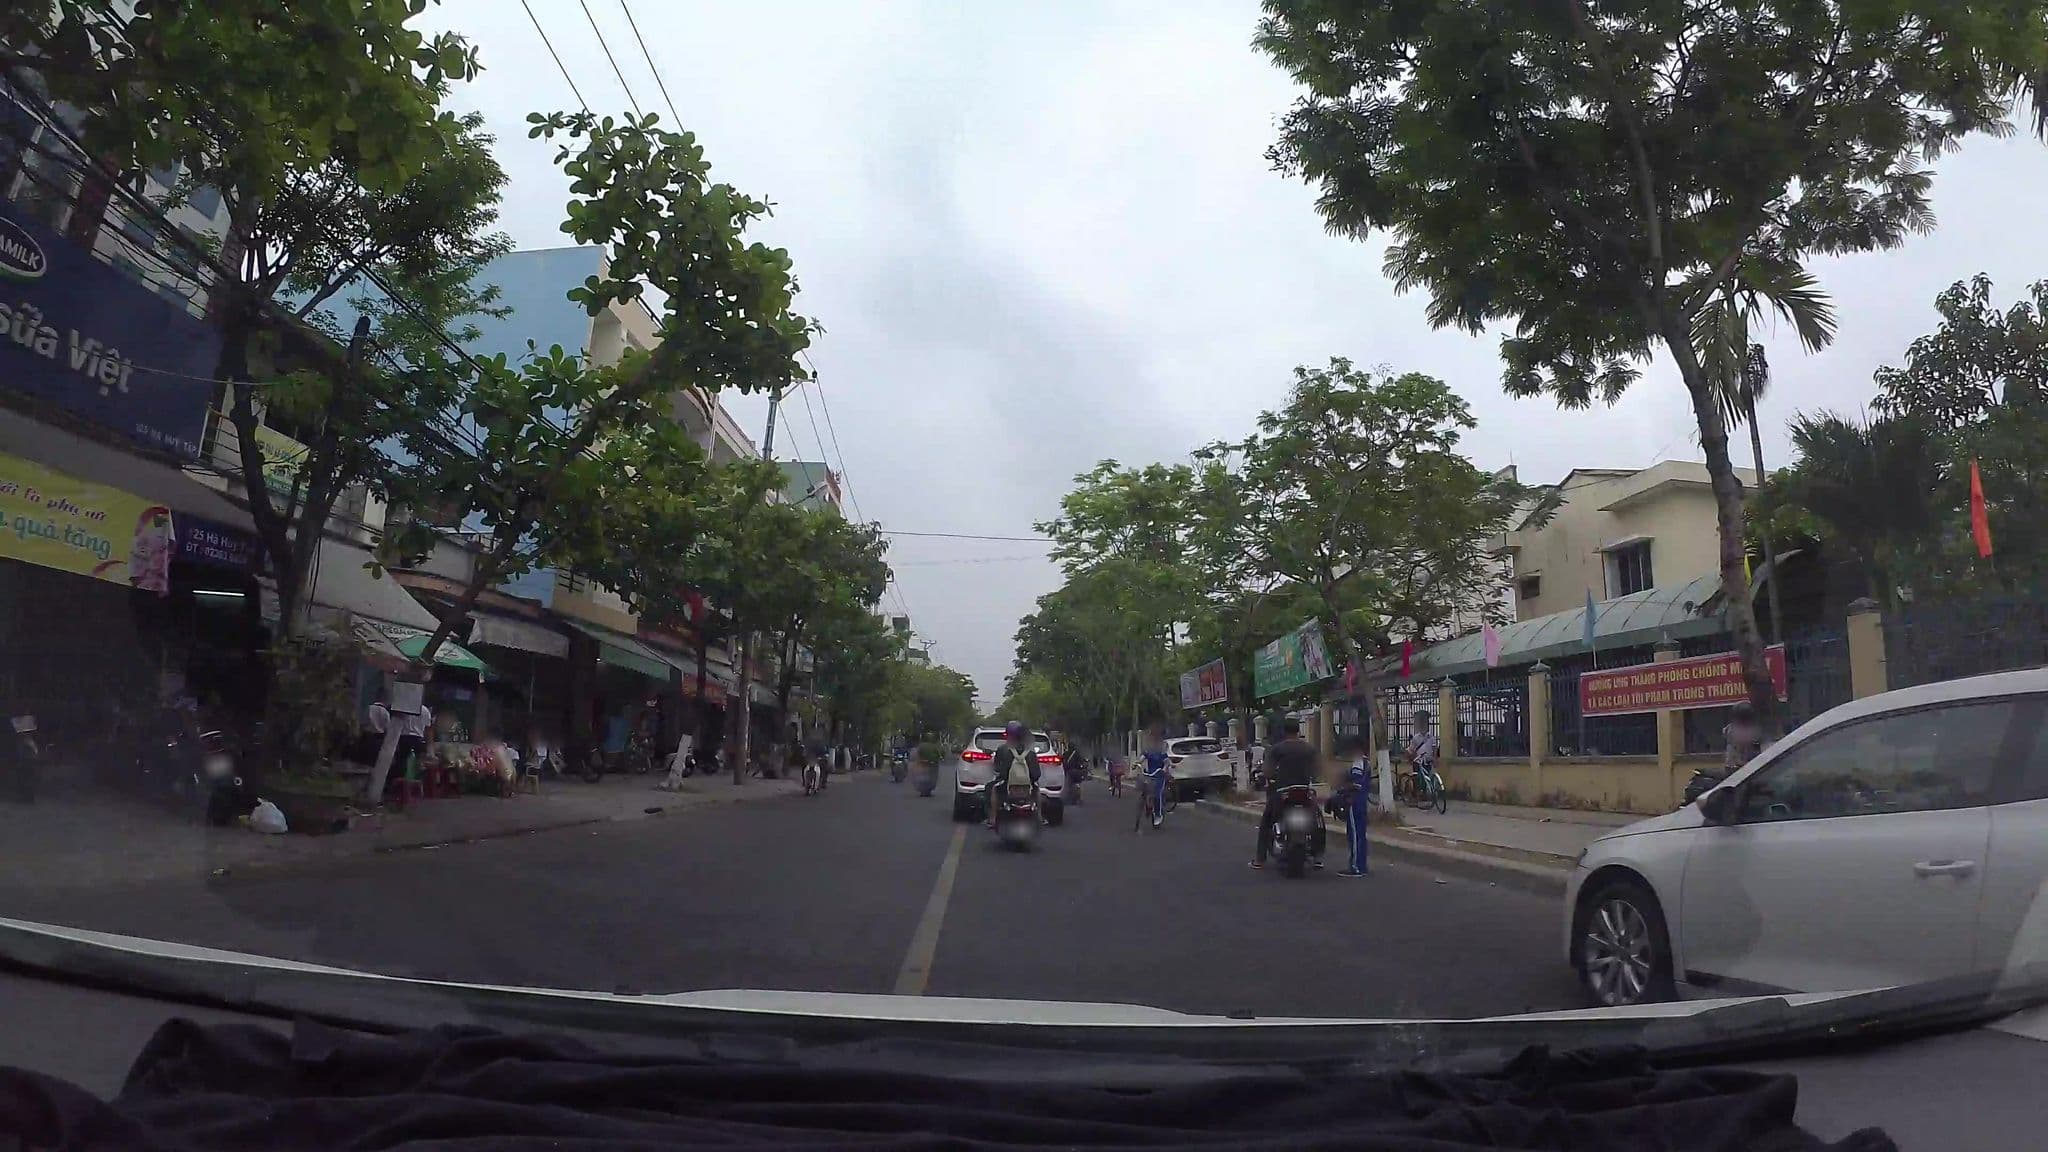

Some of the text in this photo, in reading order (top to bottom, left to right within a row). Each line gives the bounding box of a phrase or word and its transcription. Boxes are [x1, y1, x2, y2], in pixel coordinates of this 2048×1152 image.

[70, 328, 133, 396] Việt
[64, 524, 111, 561] tặng
[1658, 667, 1690, 683] PHÒNG
[1692, 659, 1727, 679] CHỐNG
[1672, 685, 1705, 700] TRONG
